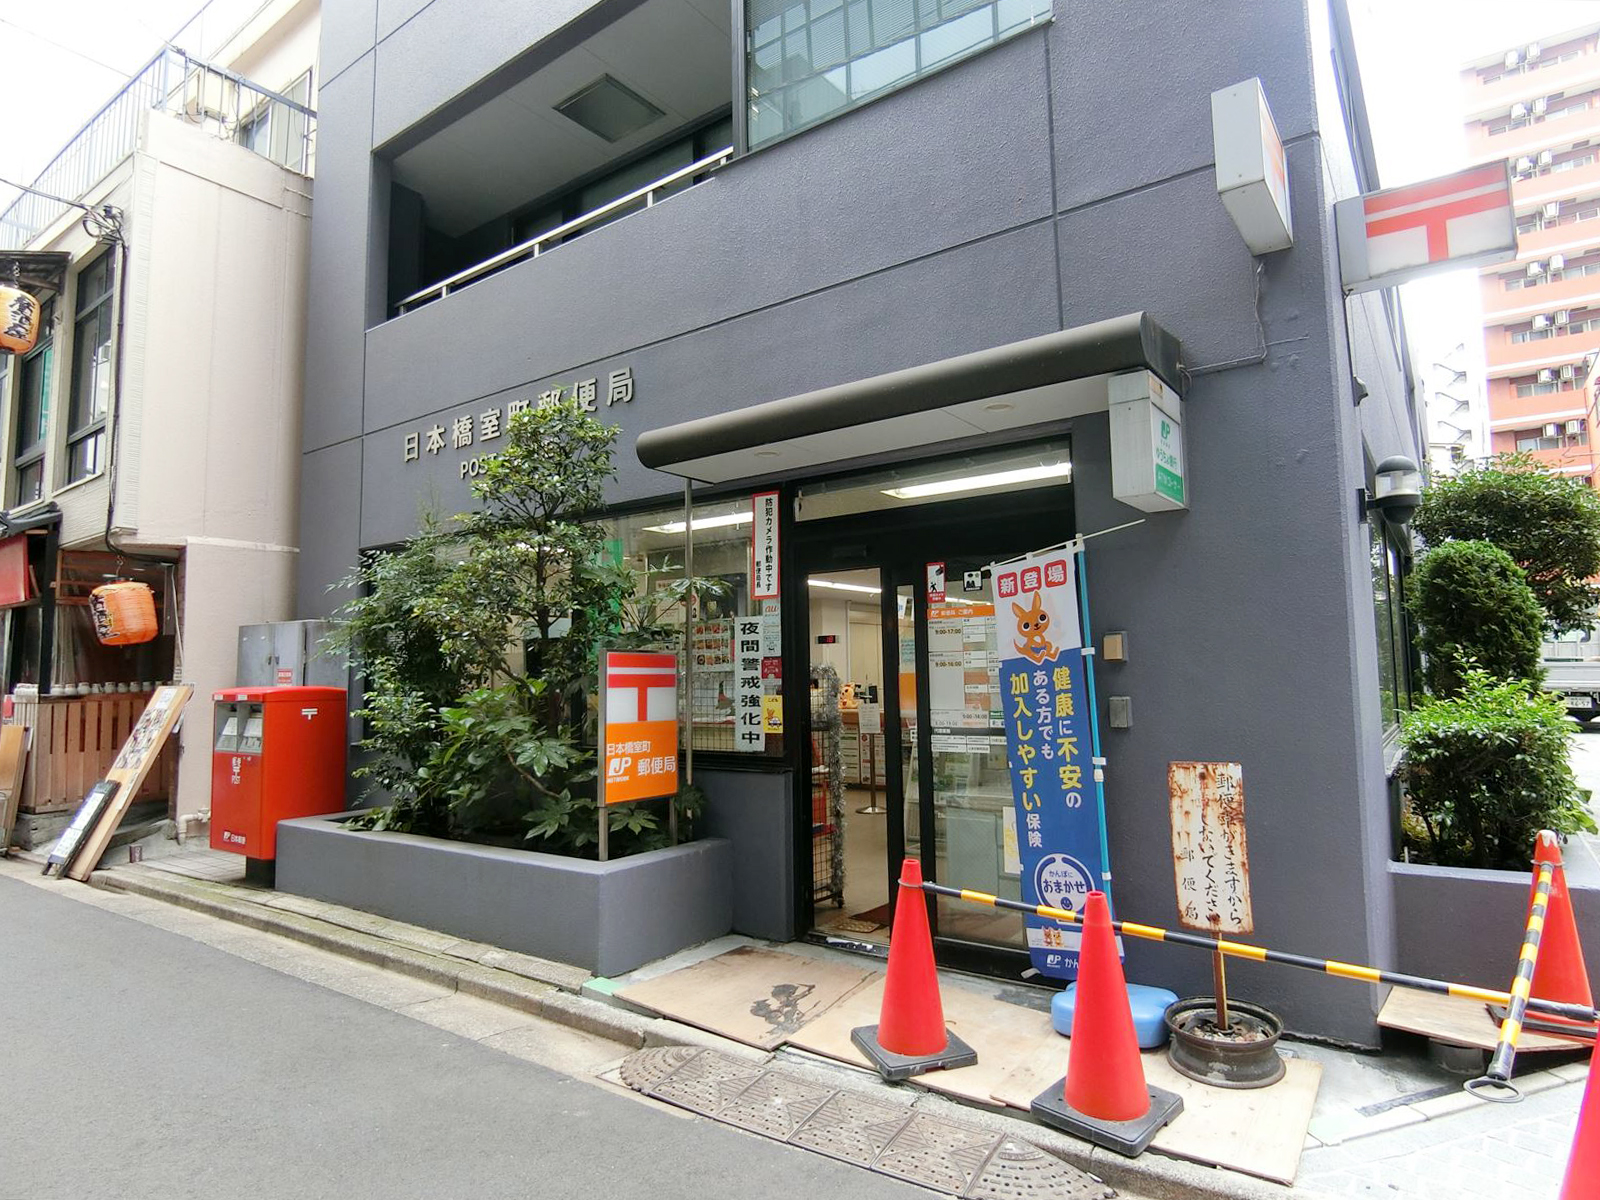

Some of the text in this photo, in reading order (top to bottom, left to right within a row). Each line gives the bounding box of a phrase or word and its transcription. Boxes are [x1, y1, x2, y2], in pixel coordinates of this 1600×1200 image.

[765, 497, 774, 593] 防犯カメラ作動中です
[999, 563, 1065, 595] 新登場
[740, 621, 762, 744] 夜間警戒強化中
[1033, 669, 1055, 760] ある方でも
[606, 740, 651, 756] 日本橋室町
[1052, 667, 1083, 808] 健康に不安の
[608, 756, 676, 776] JP 郵便局
[1009, 672, 1043, 848] 加入しやすい保険
[1043, 878, 1087, 894] おまかせ
[1049, 870, 1074, 878] かんぽに
[1046, 954, 1062, 965] JP
